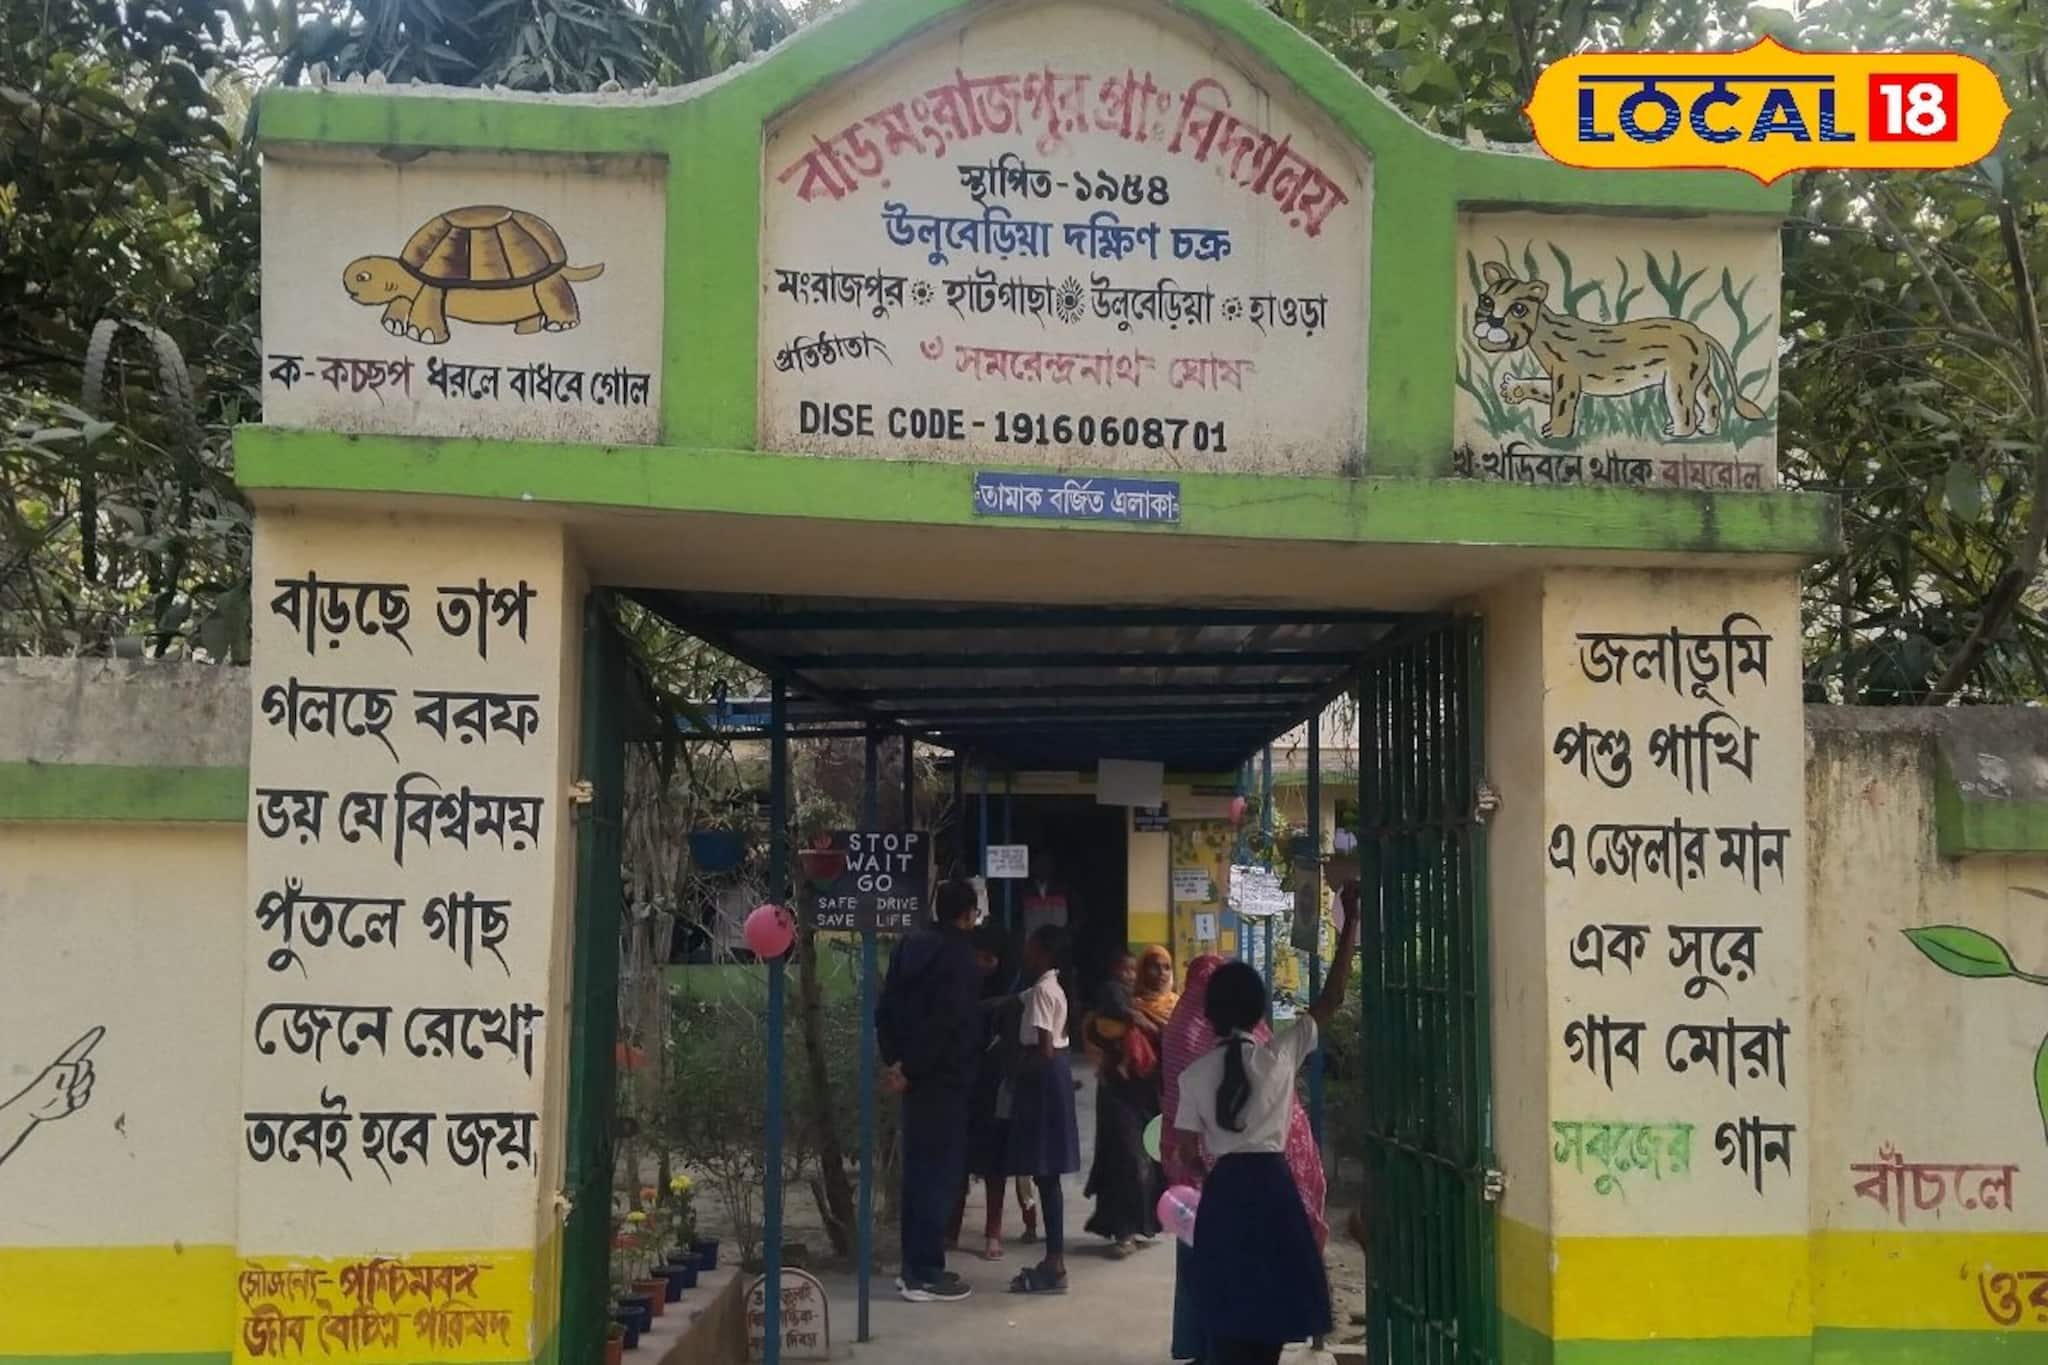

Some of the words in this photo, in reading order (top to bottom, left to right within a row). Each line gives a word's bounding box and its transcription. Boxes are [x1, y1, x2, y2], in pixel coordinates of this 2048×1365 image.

[881, 200, 1053, 266] উলুবেড়িয়া
[1063, 211, 1161, 261] দক্ষিণ
[1170, 226, 1232, 261] চক্র
[775, 266, 909, 320] মংরাজপুর
[942, 265, 1056, 329] হাটগাছা
[1090, 271, 1215, 335] উলুবেড়িয়া
[1249, 290, 1329, 338] হাওড়া
[427, 356, 501, 401] ধরলে
[591, 366, 651, 409] গোল
[800, 401, 874, 436] DISE
[1048, 479, 1105, 515] বর্জিত
[1110, 488, 1178, 519] এলাকা
[271, 570, 413, 656] বাড়ছে
[436, 577, 538, 664] তাপ
[1576, 612, 1773, 708] জলাভূমি
[261, 676, 400, 764] গলছে
[413, 690, 541, 746] বরফ
[1553, 721, 1633, 788] পশু
[1649, 710, 1760, 796] পাখি
[256, 788, 330, 845] ভয়
[339, 792, 389, 844] যে
[394, 771, 545, 869] বিশ্বময়
[850, 834, 918, 850] STOP
[1548, 823, 1576, 878] এ
[1587, 817, 1710, 892] জেলার
[1715, 821, 1791, 894] মান
[846, 855, 913, 872] WAIT
[857, 875, 892, 892] GO
[255, 876, 407, 979] পুঁতলে
[422, 891, 513, 977] গাছ
[817, 914, 855, 927] SAVE
[876, 914, 912, 927] LIFE
[818, 897, 857, 910] SAFE
[876, 897, 918, 910] DRIVE
[1570, 924, 1651, 976] এক
[1668, 925, 1763, 1000] সুরে
[255, 1003, 392, 1064] জেনে
[404, 1003, 544, 1080] রেখো
[1565, 1014, 1647, 1091] গাব
[1666, 1017, 1791, 1090] মোরা
[244, 1085, 352, 1182] তবেই
[359, 1112, 437, 1185] হবে
[1715, 1116, 1797, 1197] গান
[1850, 1140, 2020, 1226] বাঁচলে
